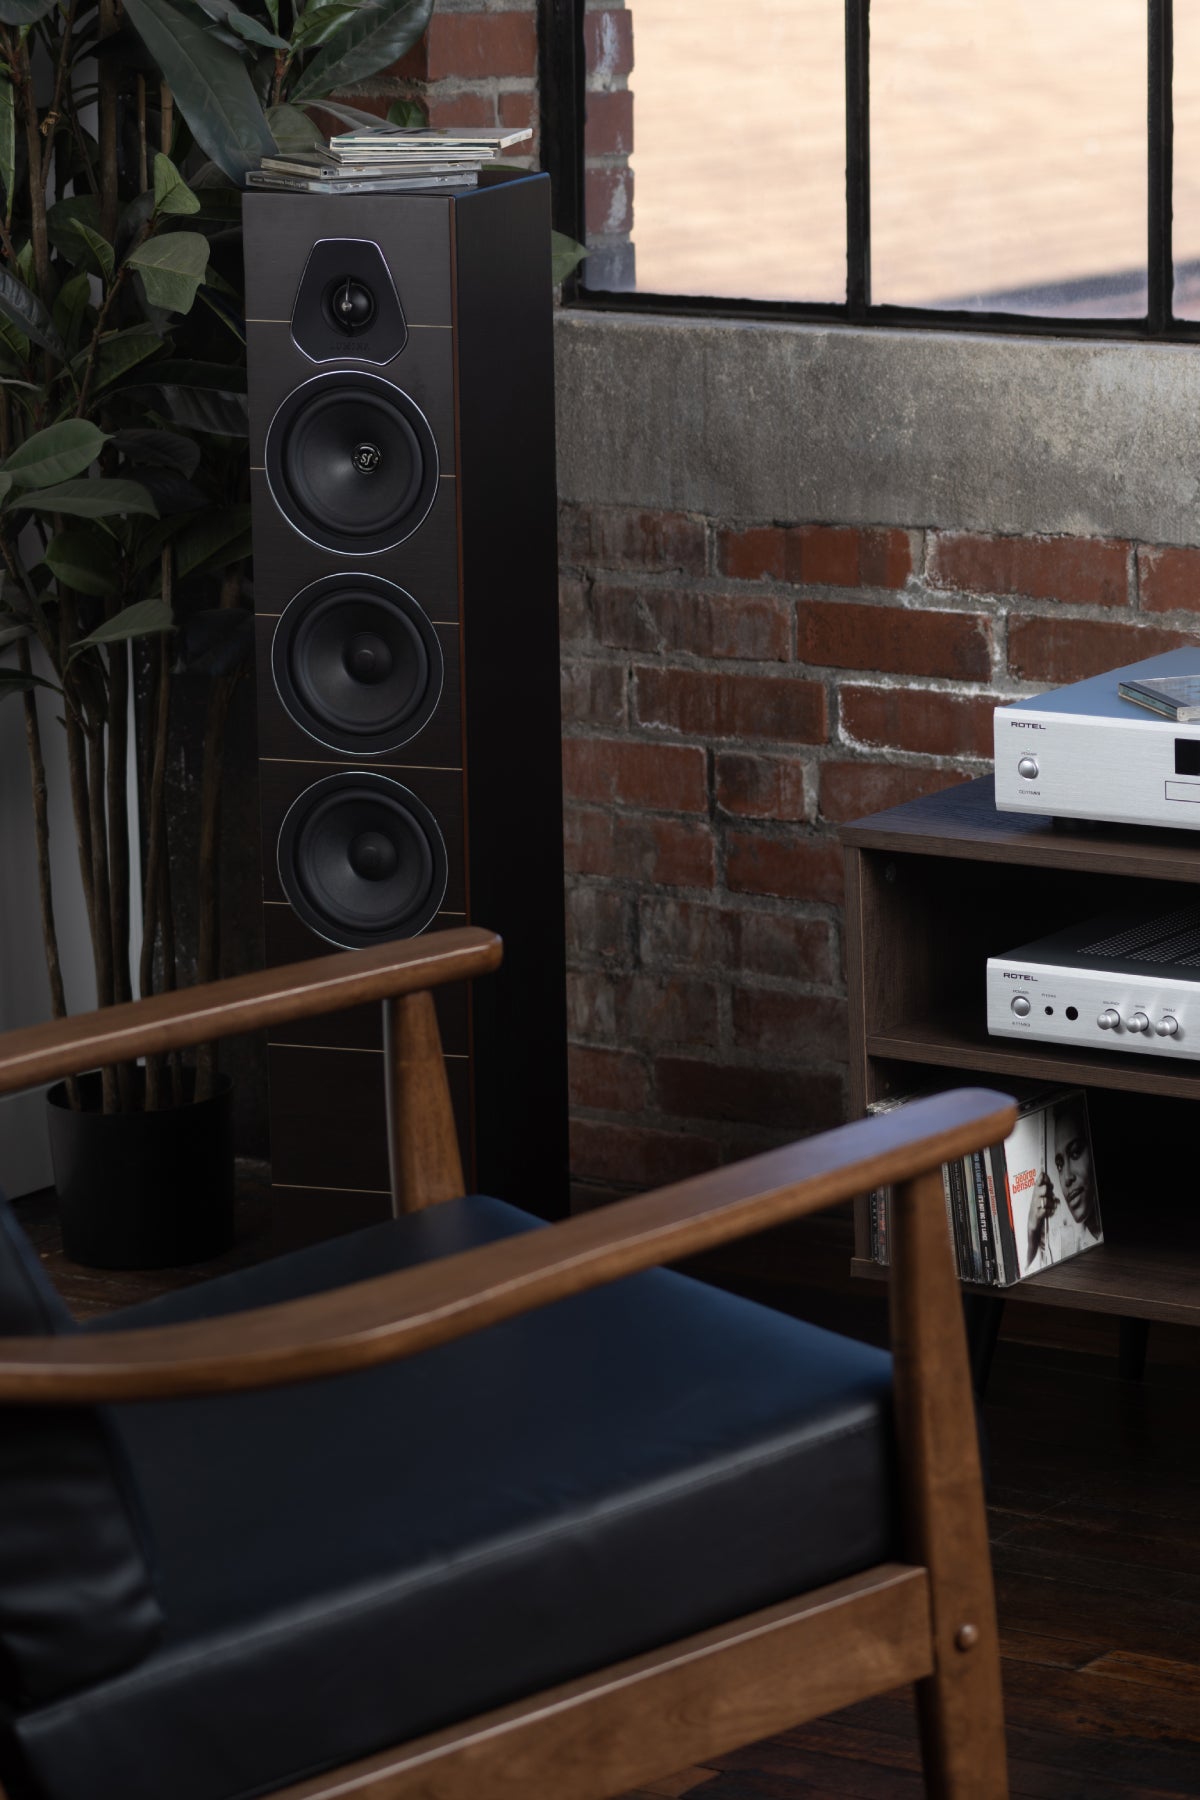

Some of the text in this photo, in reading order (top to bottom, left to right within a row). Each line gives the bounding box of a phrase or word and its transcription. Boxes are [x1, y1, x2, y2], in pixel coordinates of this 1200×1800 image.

[1011, 721, 1046, 730] ROTEL
[1003, 972, 1039, 982] ROTEL
[1015, 1168, 1037, 1184] george
